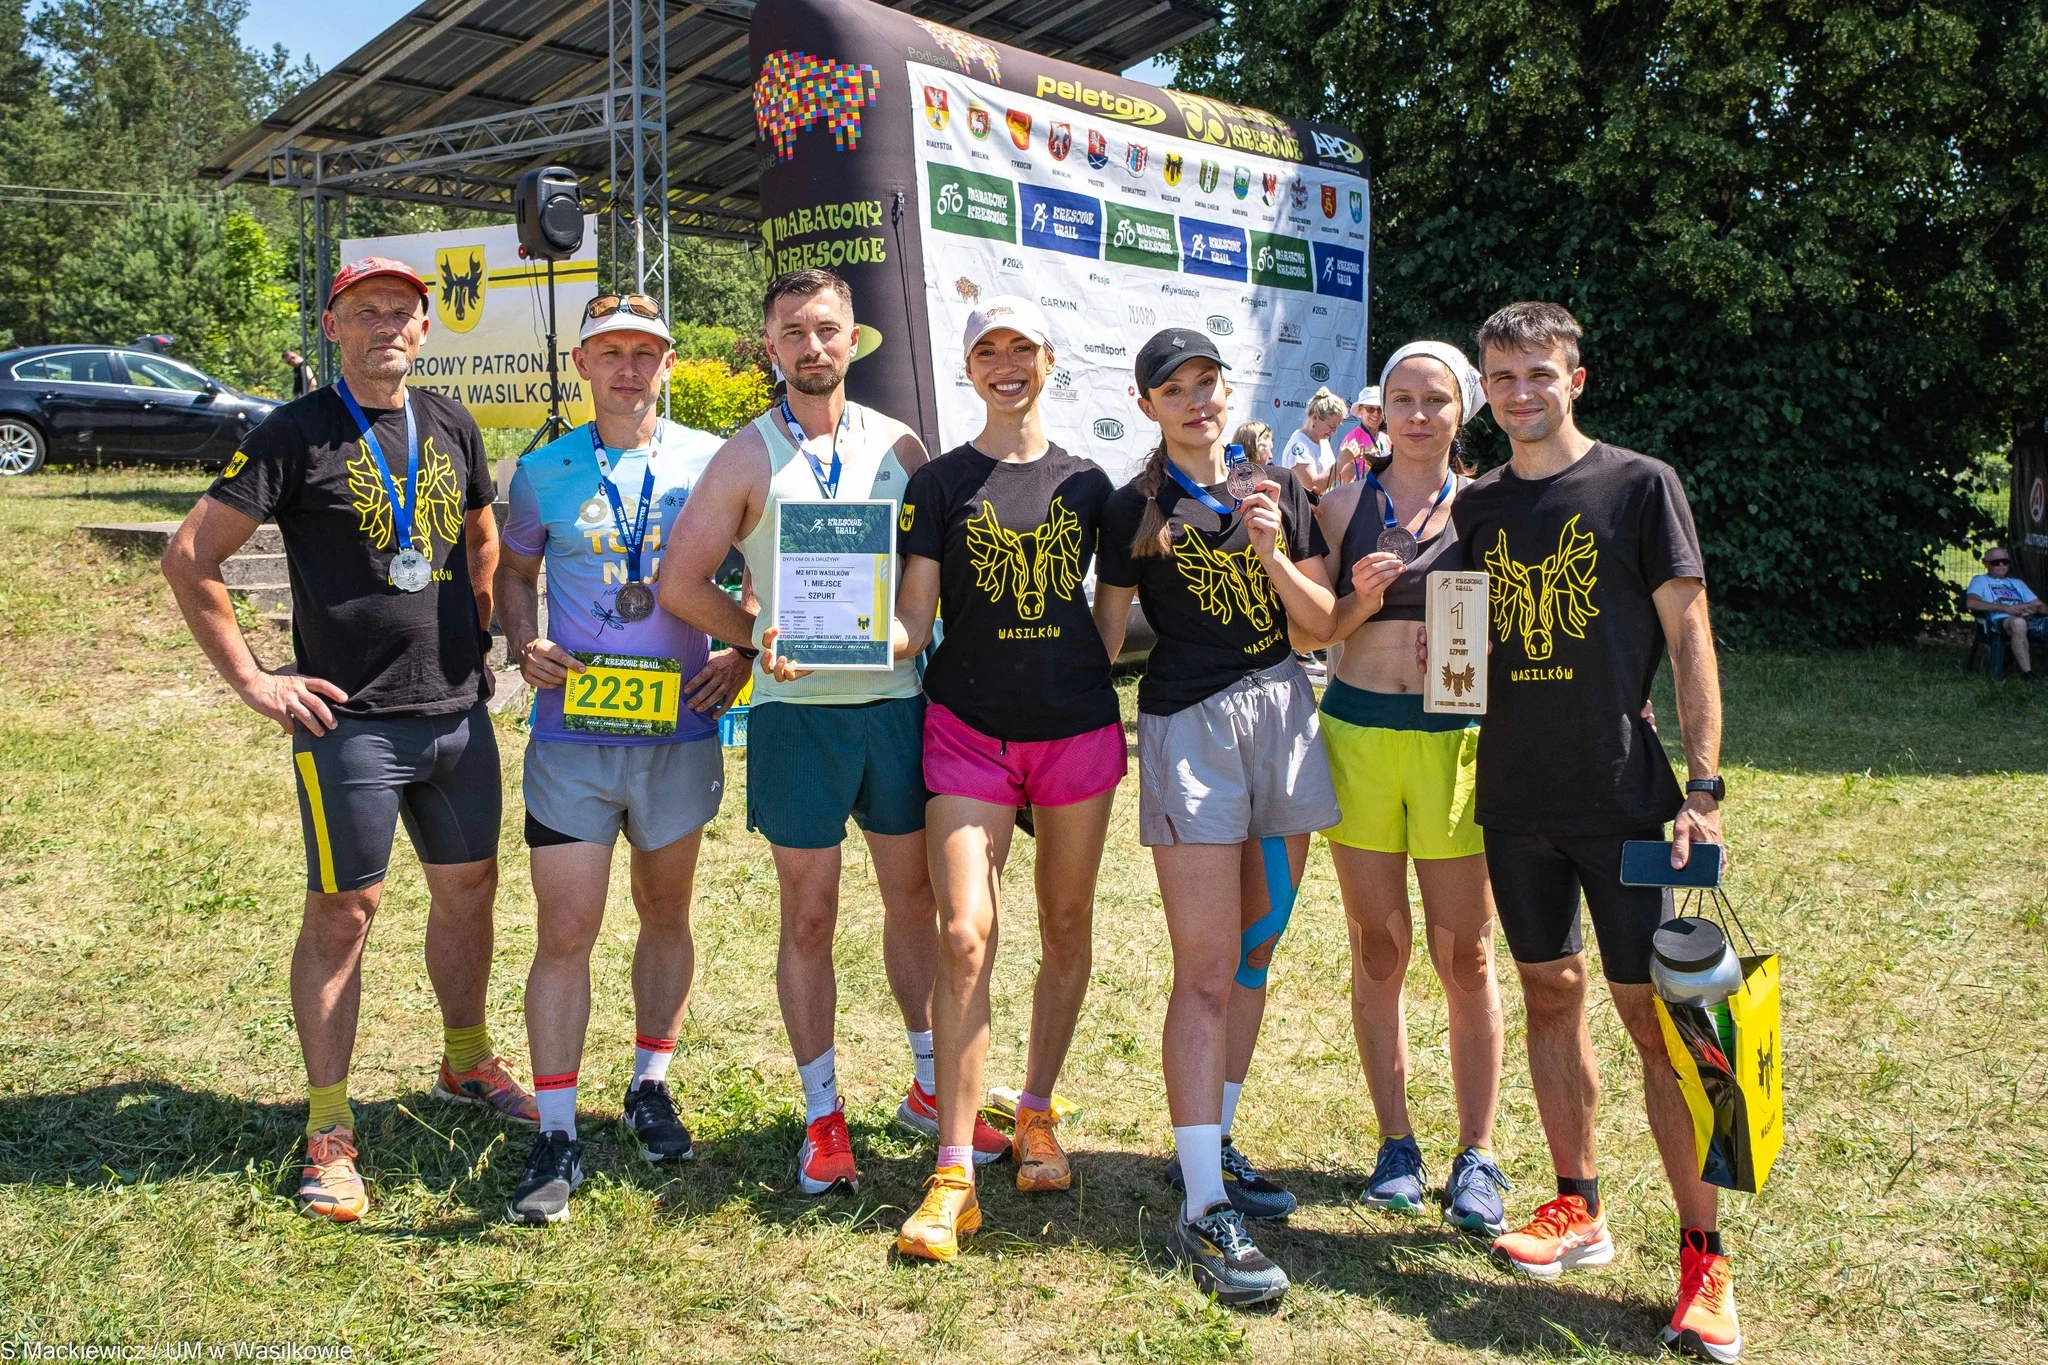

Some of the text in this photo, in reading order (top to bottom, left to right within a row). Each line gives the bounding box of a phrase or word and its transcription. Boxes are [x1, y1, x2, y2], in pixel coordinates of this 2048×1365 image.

[907, 46, 960, 71] Podlaskie
[1036, 74, 1156, 121] peleton
[1228, 122, 1304, 161] KRESOWE
[1011, 159, 1032, 170] TYKOCIN
[967, 186, 1008, 208] MARATONY
[775, 201, 883, 242] MARATONY
[967, 205, 1008, 226] KRESOWE
[1053, 206, 1094, 226] KRESOWE
[1053, 223, 1078, 239] TRAIL
[1138, 237, 1173, 255] KRESOWE
[1208, 236, 1241, 253] KRESOWE
[776, 237, 886, 276] KRESOWE
[1002, 257, 1023, 270] #2026
[1210, 251, 1232, 265] TRAIL
[1089, 272, 1110, 286] #Pasja
[1161, 283, 1200, 299] #Rywalizacja
[1041, 296, 1076, 311] GARMIN
[1312, 306, 1328, 316] #2026
[1128, 305, 1156, 326] NJORD
[1066, 390, 1078, 399] LINE
[827, 518, 863, 527] KRESOWE
[835, 526, 858, 535] TRAIL
[811, 580, 842, 588] MIEJSCE
[1455, 577, 1483, 586] KRESOWE
[808, 592, 836, 600] SZPURT
[1450, 601, 1464, 630] 1
[998, 625, 1061, 640] WASILKÓW
[1452, 638, 1466, 646] OPEN
[1449, 648, 1469, 656] SZPURT
[605, 657, 660, 670] KRESOWE TRAIL
[1511, 665, 1574, 682] WASILKÓW
[568, 677, 577, 702] SZPURT
[576, 673, 664, 713] 2231
